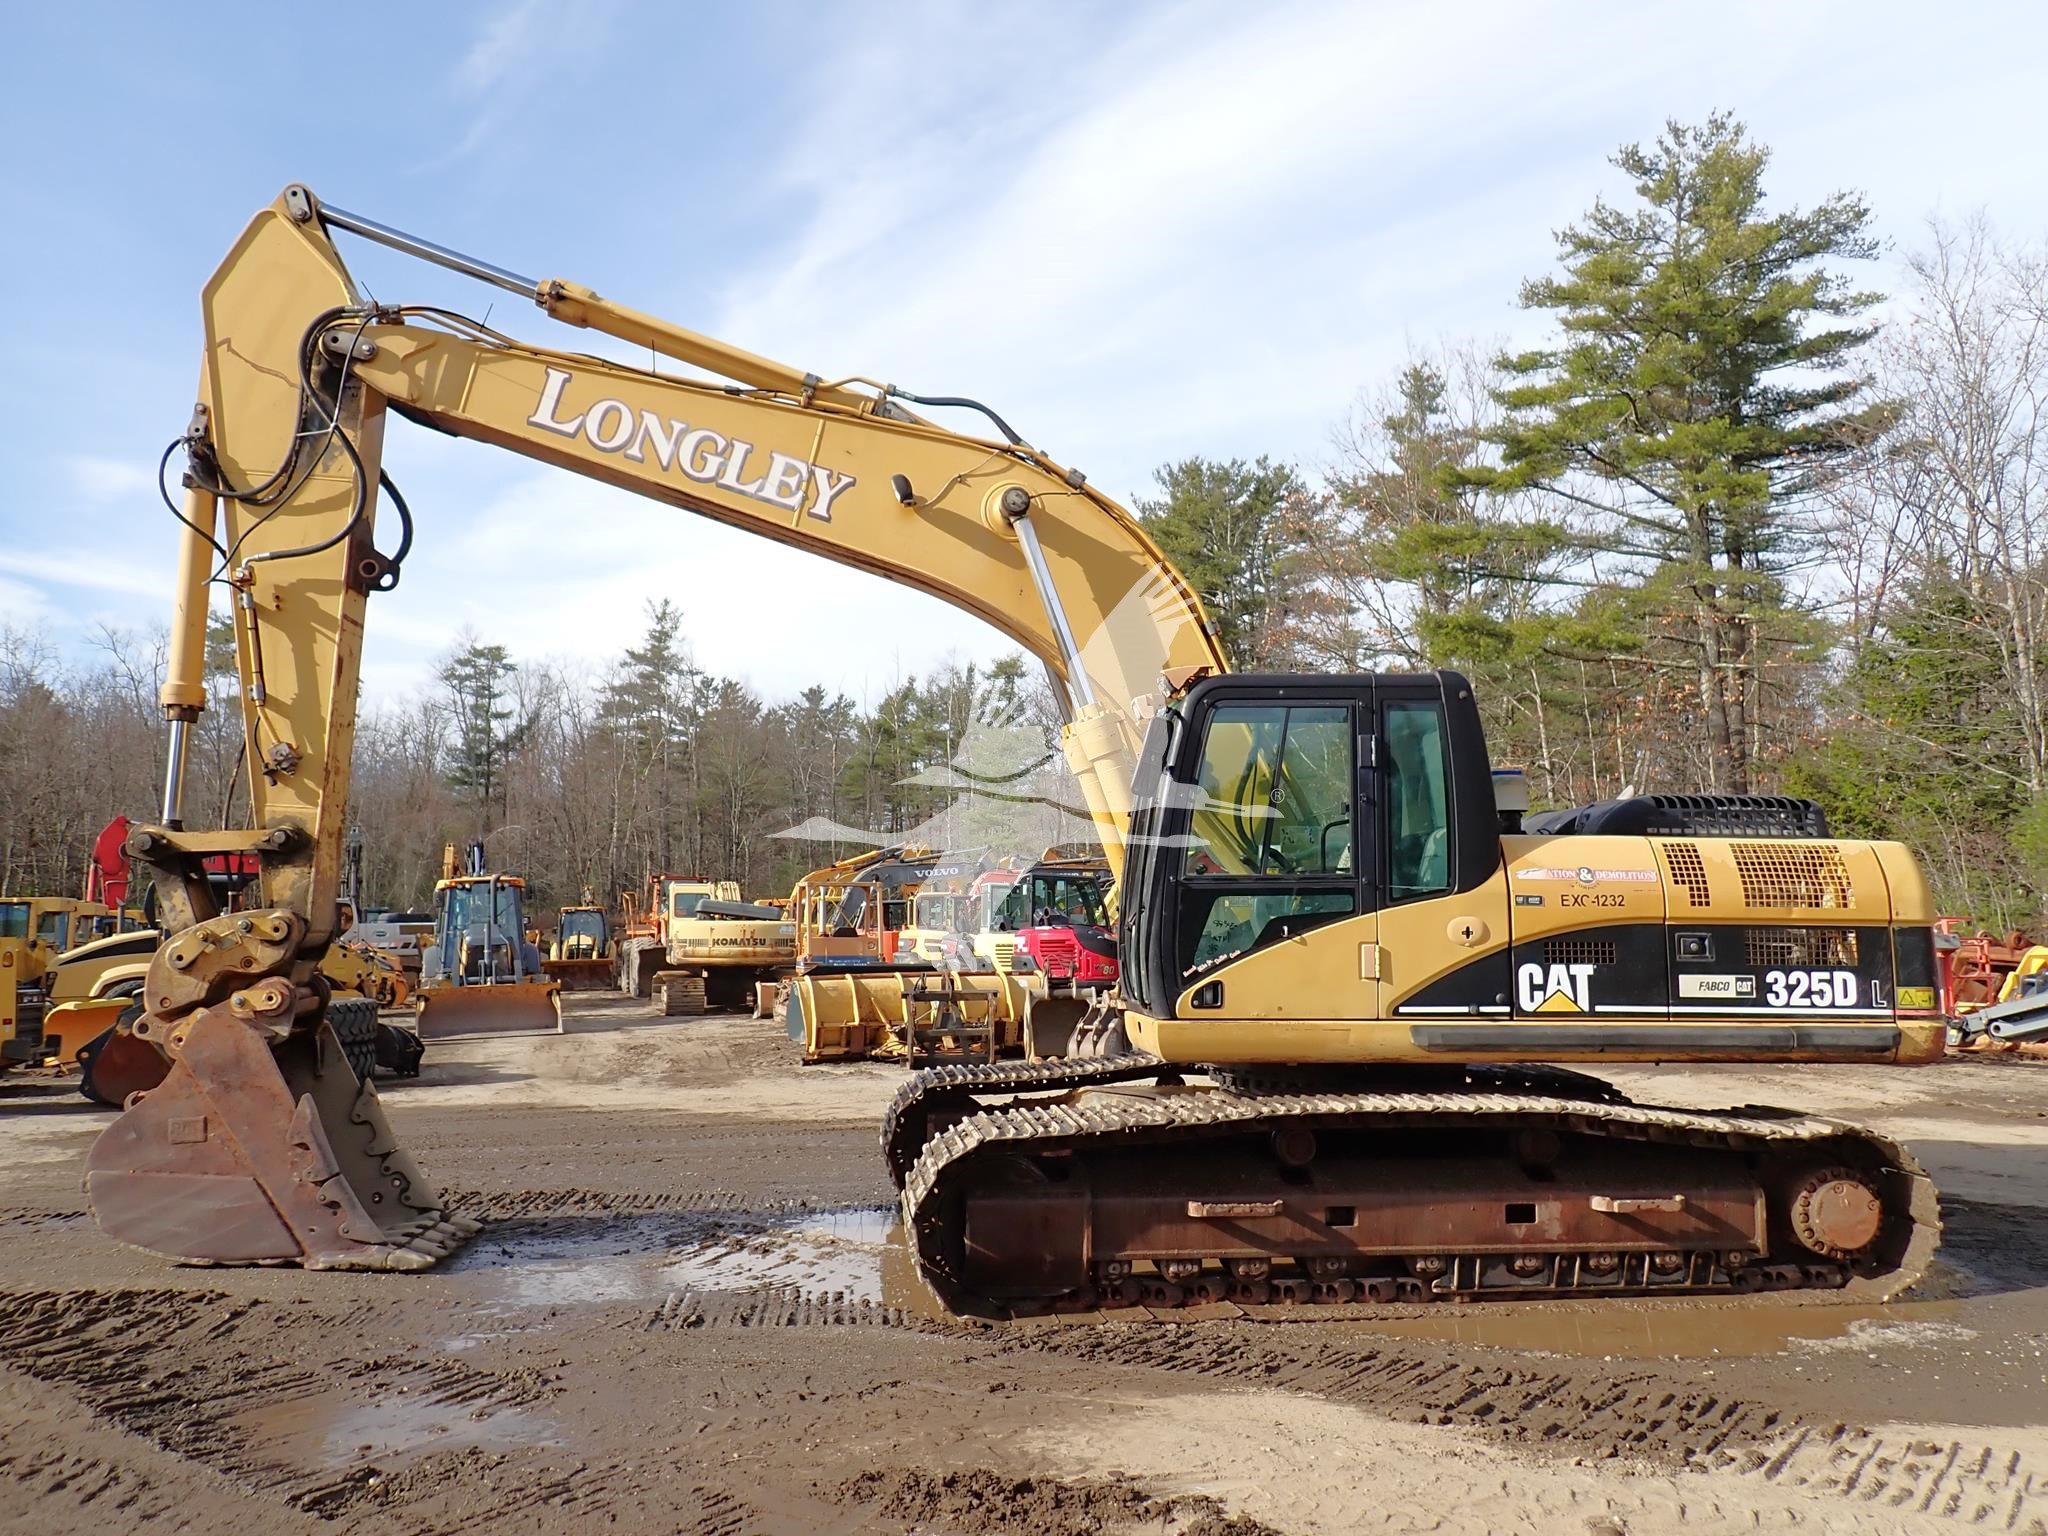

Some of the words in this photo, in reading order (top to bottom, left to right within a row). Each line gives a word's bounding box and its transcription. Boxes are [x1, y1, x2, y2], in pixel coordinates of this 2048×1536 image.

[527, 366, 857, 523] LONGLEY
[914, 867, 959, 878] VOLVO
[1579, 867, 1594, 881] &
[711, 937, 767, 947] KOMATSU
[1518, 963, 1595, 1012] CAT
[1698, 981, 1731, 992] FABCO
[1765, 970, 1857, 1008] 325D
[1871, 980, 1888, 1008] L
